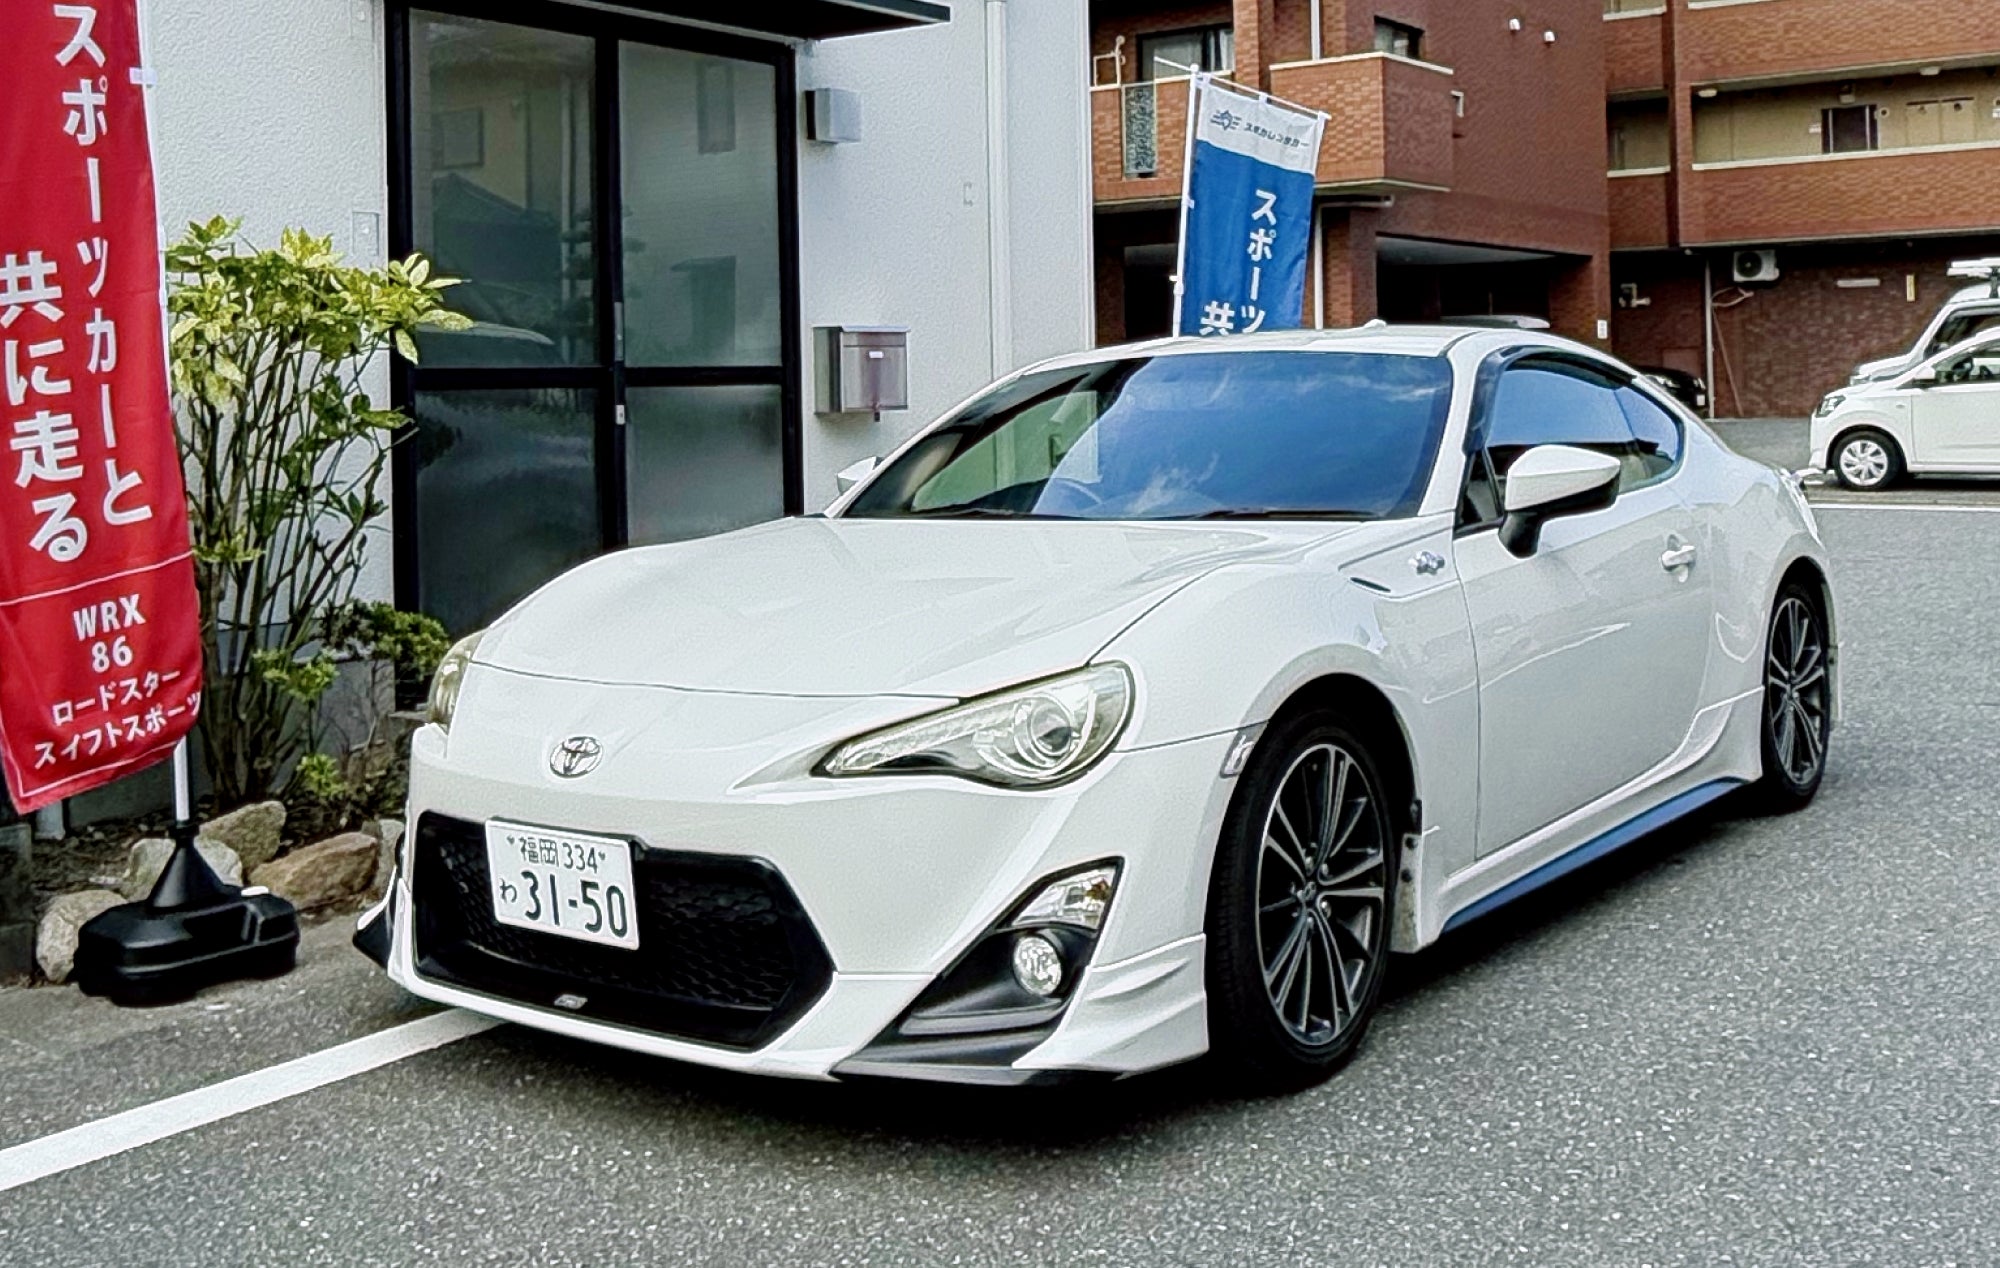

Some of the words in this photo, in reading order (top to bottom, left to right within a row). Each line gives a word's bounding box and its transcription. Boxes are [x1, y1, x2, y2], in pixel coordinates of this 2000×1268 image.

[53, 5, 152, 526] スポーツカーと
[1241, 189, 1277, 334] スポーツ
[1199, 301, 1235, 336] 共
[0, 250, 88, 562] 共に走る
[73, 594, 146, 641] WRX
[91, 636, 133, 672] 86
[52, 670, 181, 727] ロードスター
[34, 691, 200, 770] スイフトスポーツ
[518, 836, 560, 867] 福岡
[562, 842, 598, 874] 334
[499, 877, 518, 904] わ
[520, 869, 628, 939] 31-50
